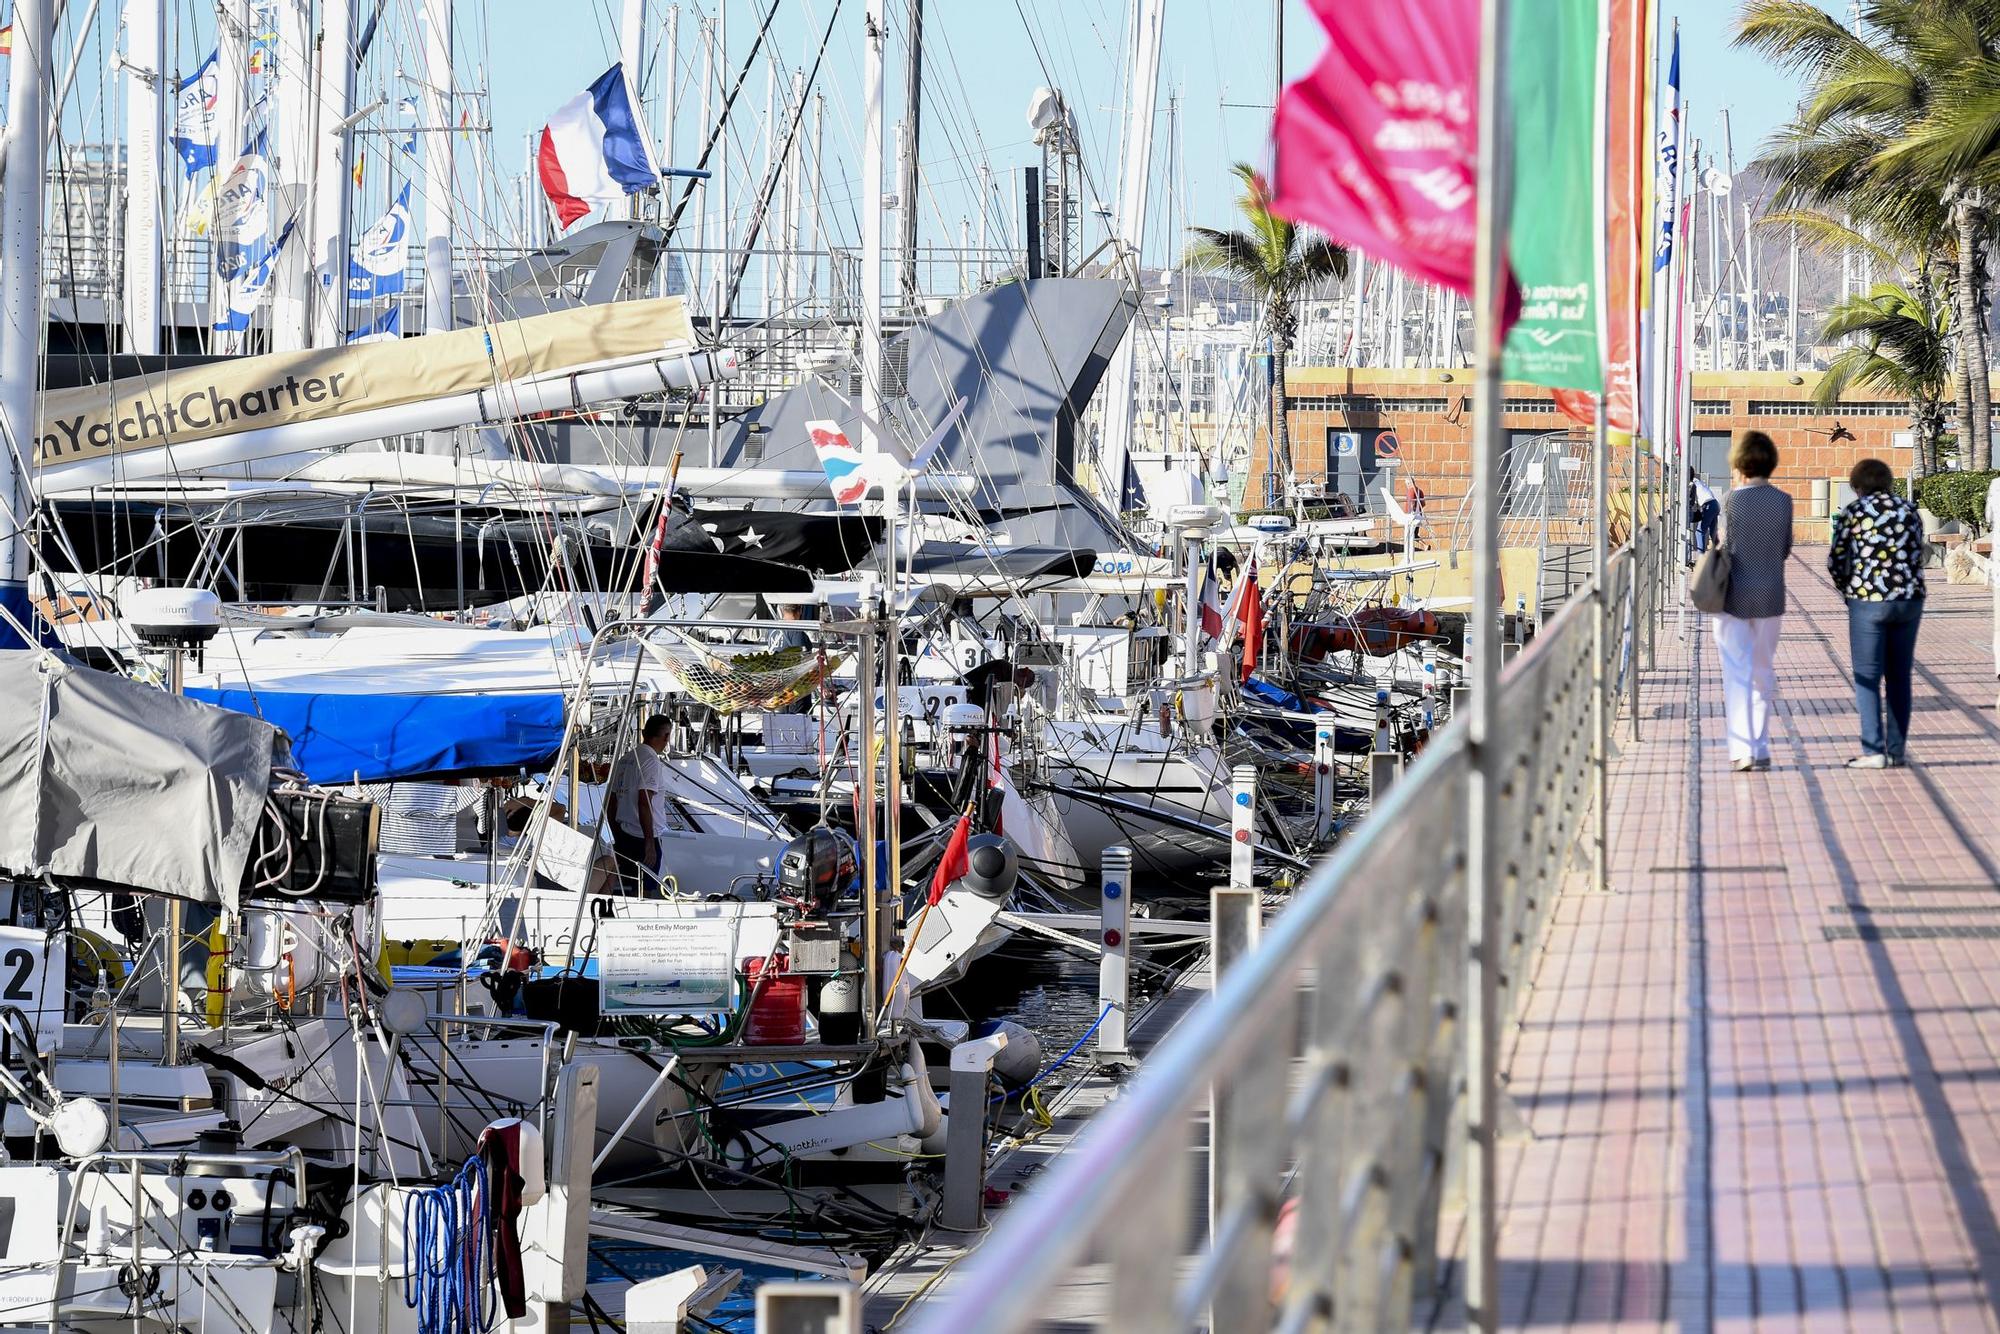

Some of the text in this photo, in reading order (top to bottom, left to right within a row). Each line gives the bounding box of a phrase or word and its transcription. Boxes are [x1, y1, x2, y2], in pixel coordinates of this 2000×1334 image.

[783, 867, 798, 878] 15
[655, 923, 672, 931] Emily
[673, 923, 698, 931] Morgan
